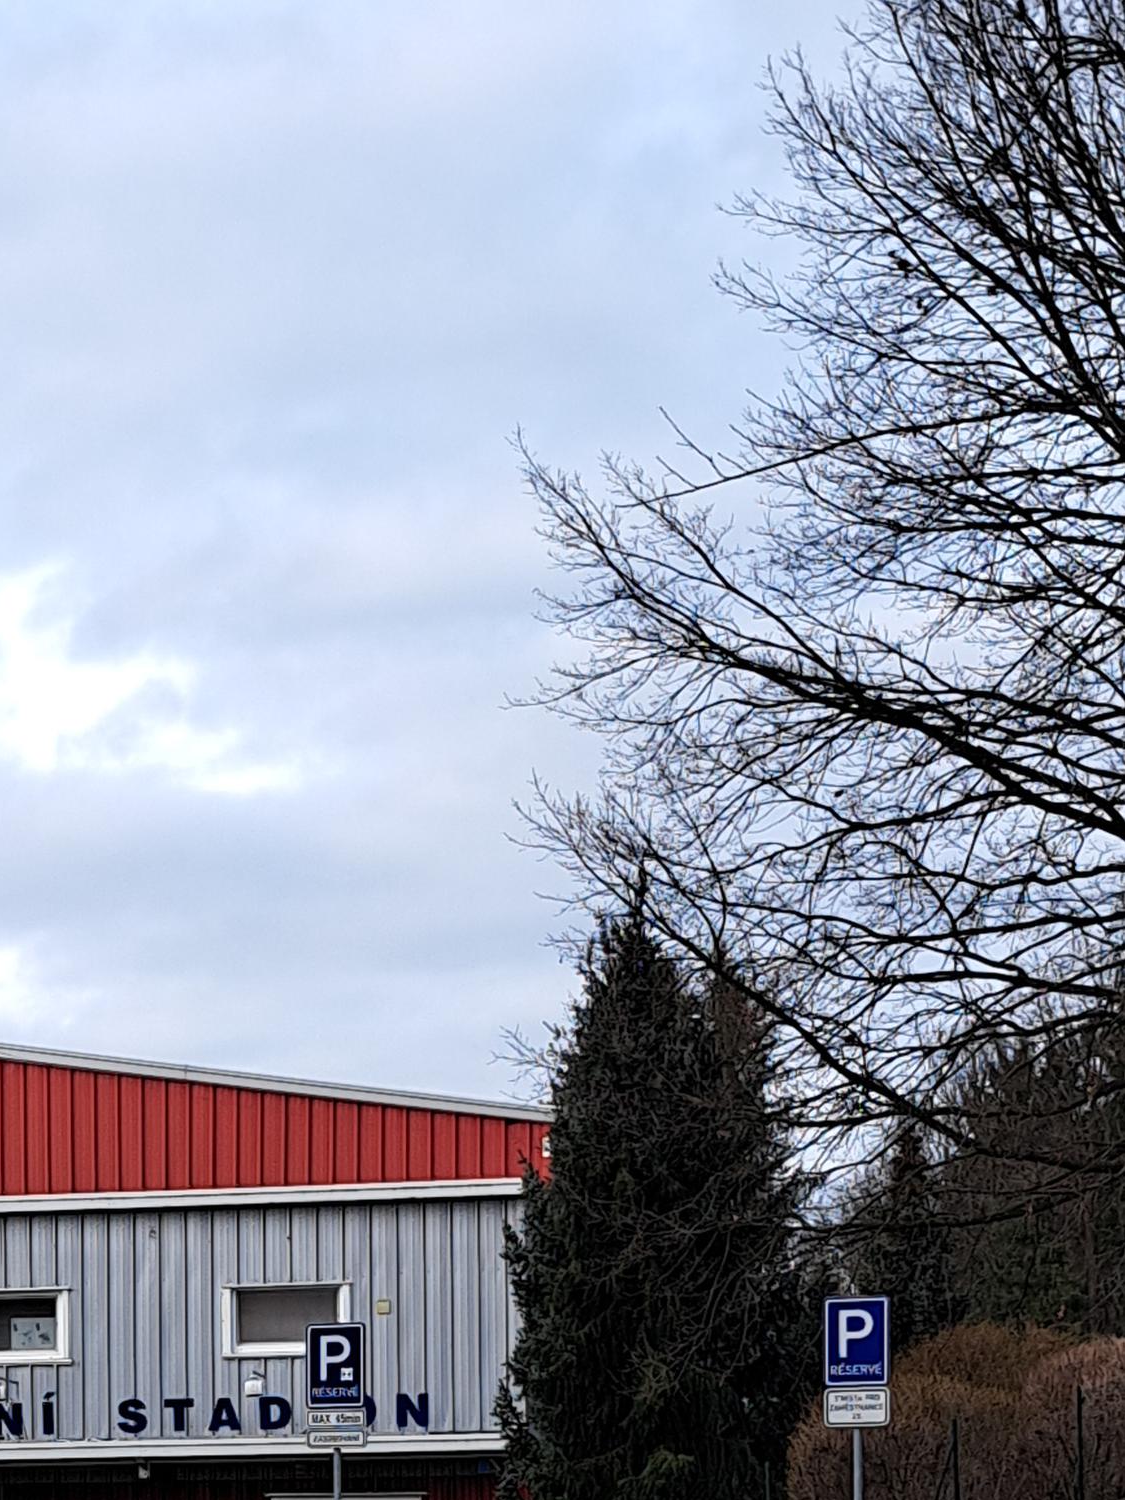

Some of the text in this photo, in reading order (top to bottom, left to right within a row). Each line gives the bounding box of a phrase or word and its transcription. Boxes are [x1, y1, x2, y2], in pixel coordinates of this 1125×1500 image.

[838, 1309, 874, 1358] P
[320, 1335, 351, 1381] P
[117, 1392, 430, 1434] STADN
[311, 1414, 331, 1425] MAX
